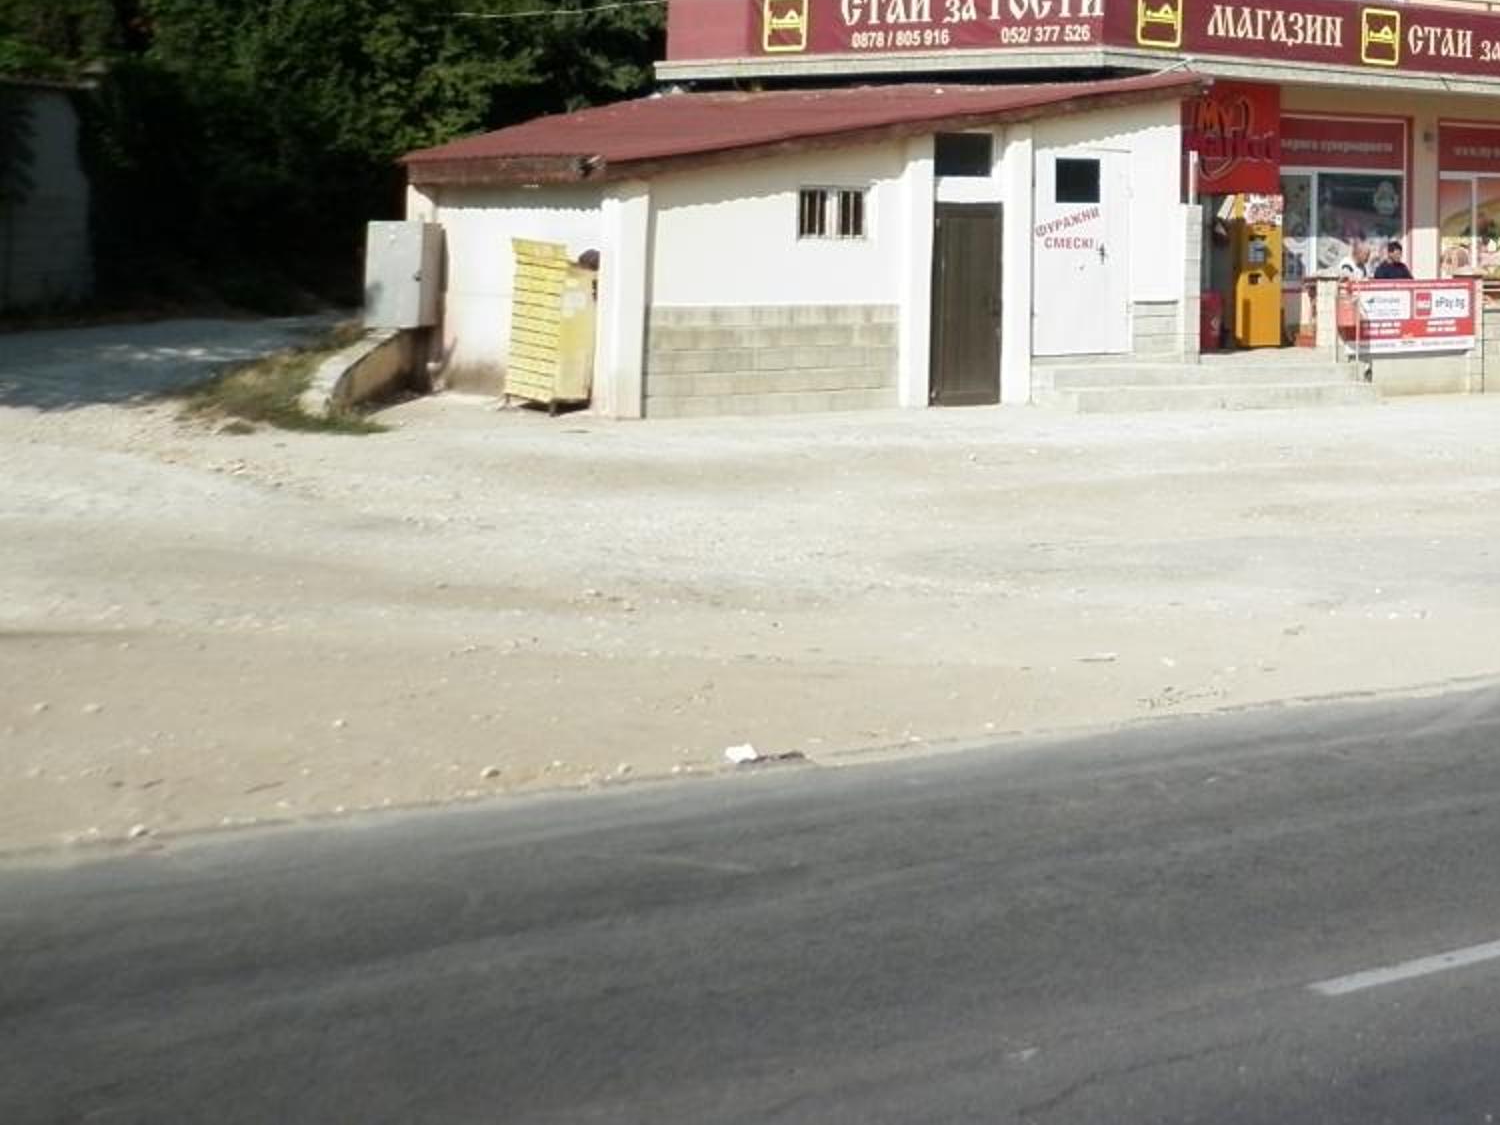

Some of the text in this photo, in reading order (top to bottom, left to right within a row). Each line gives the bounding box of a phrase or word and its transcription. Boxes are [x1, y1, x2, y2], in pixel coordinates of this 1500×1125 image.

[923, 27, 951, 46] 916
[1034, 25, 1061, 42] 377
[1064, 24, 1091, 41] 526
[1206, 3, 1343, 47] МАГАЗИН
[1407, 24, 1473, 58] СТАИ
